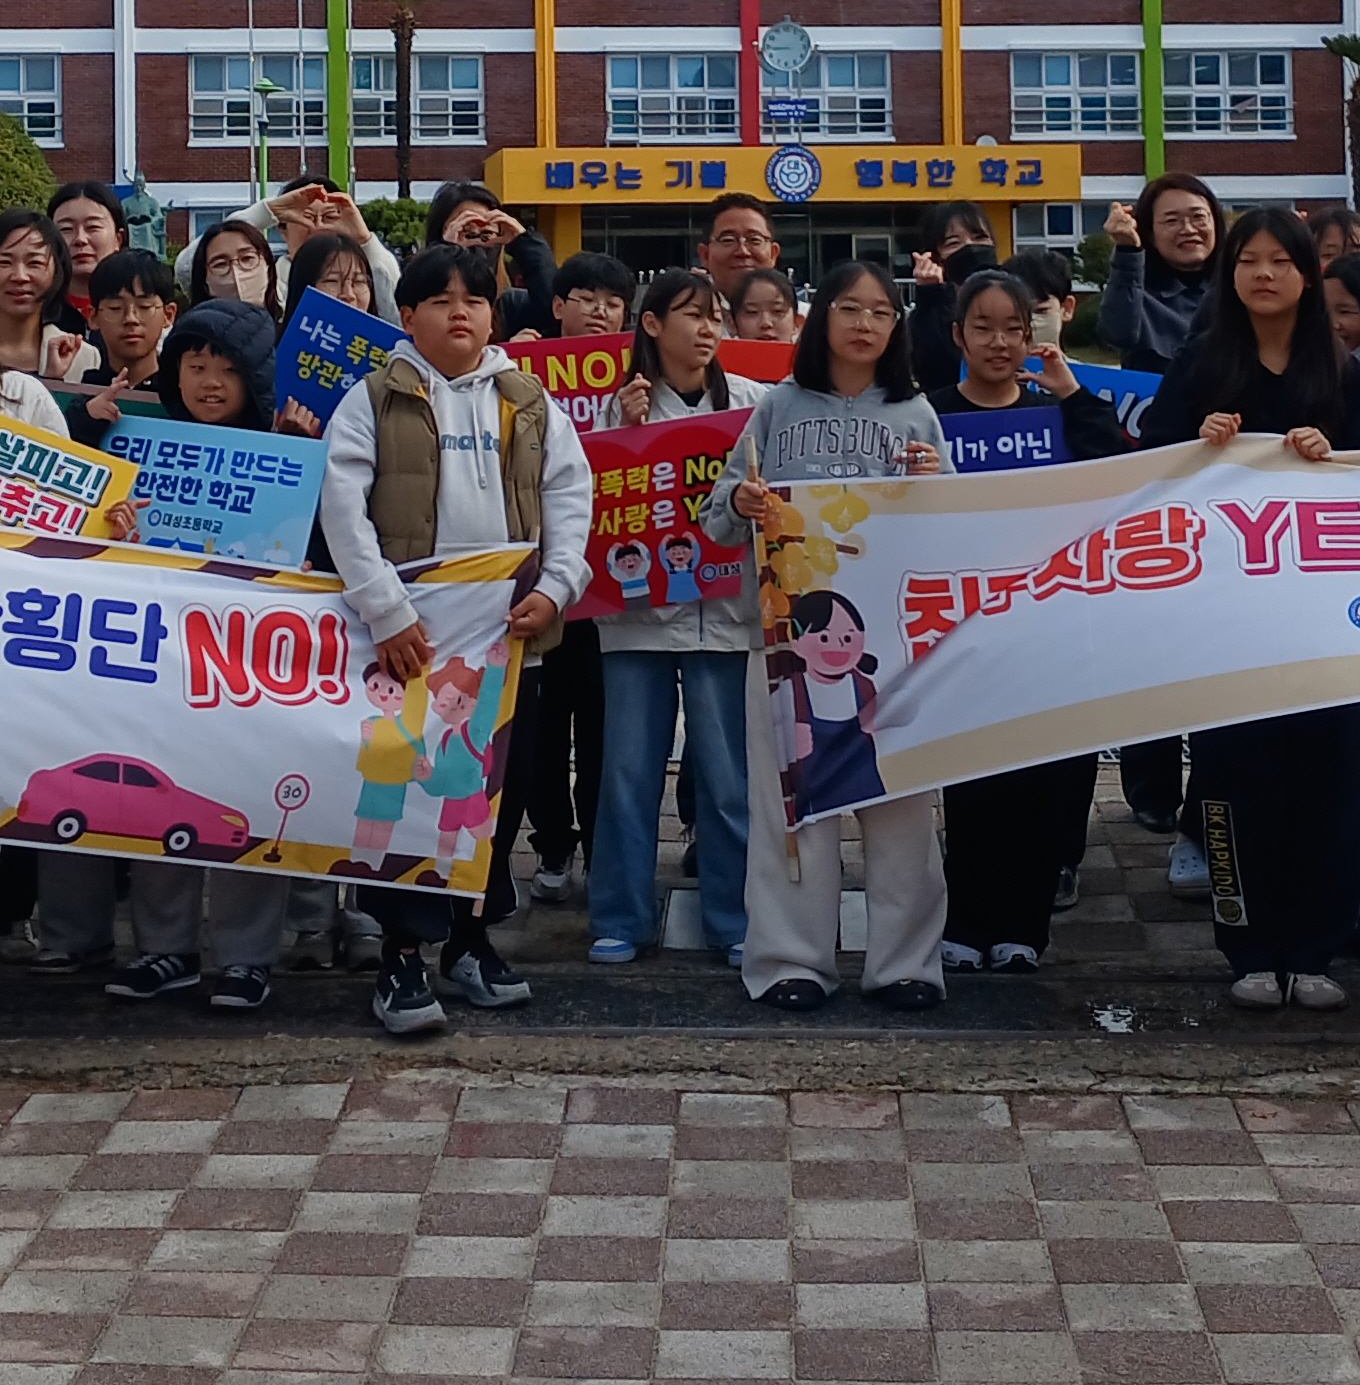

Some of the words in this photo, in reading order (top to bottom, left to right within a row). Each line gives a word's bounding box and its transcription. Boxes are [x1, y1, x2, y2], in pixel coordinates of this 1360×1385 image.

[544, 160, 643, 190] 배우는
[854, 158, 956, 189] 행복한
[979, 158, 1044, 187] 학교
[299, 315, 342, 353] 나는
[996, 428, 1052, 460] 아닌
[153, 440, 226, 476] 모두가
[229, 450, 304, 488] 만드는
[132, 470, 204, 506] 안전한
[207, 479, 256, 515] 학교
[178, 601, 350, 709] NO!
[282, 784, 302, 799] 30
[1207, 804, 1227, 826] BK
[1207, 827, 1236, 896] HAPKIDO
